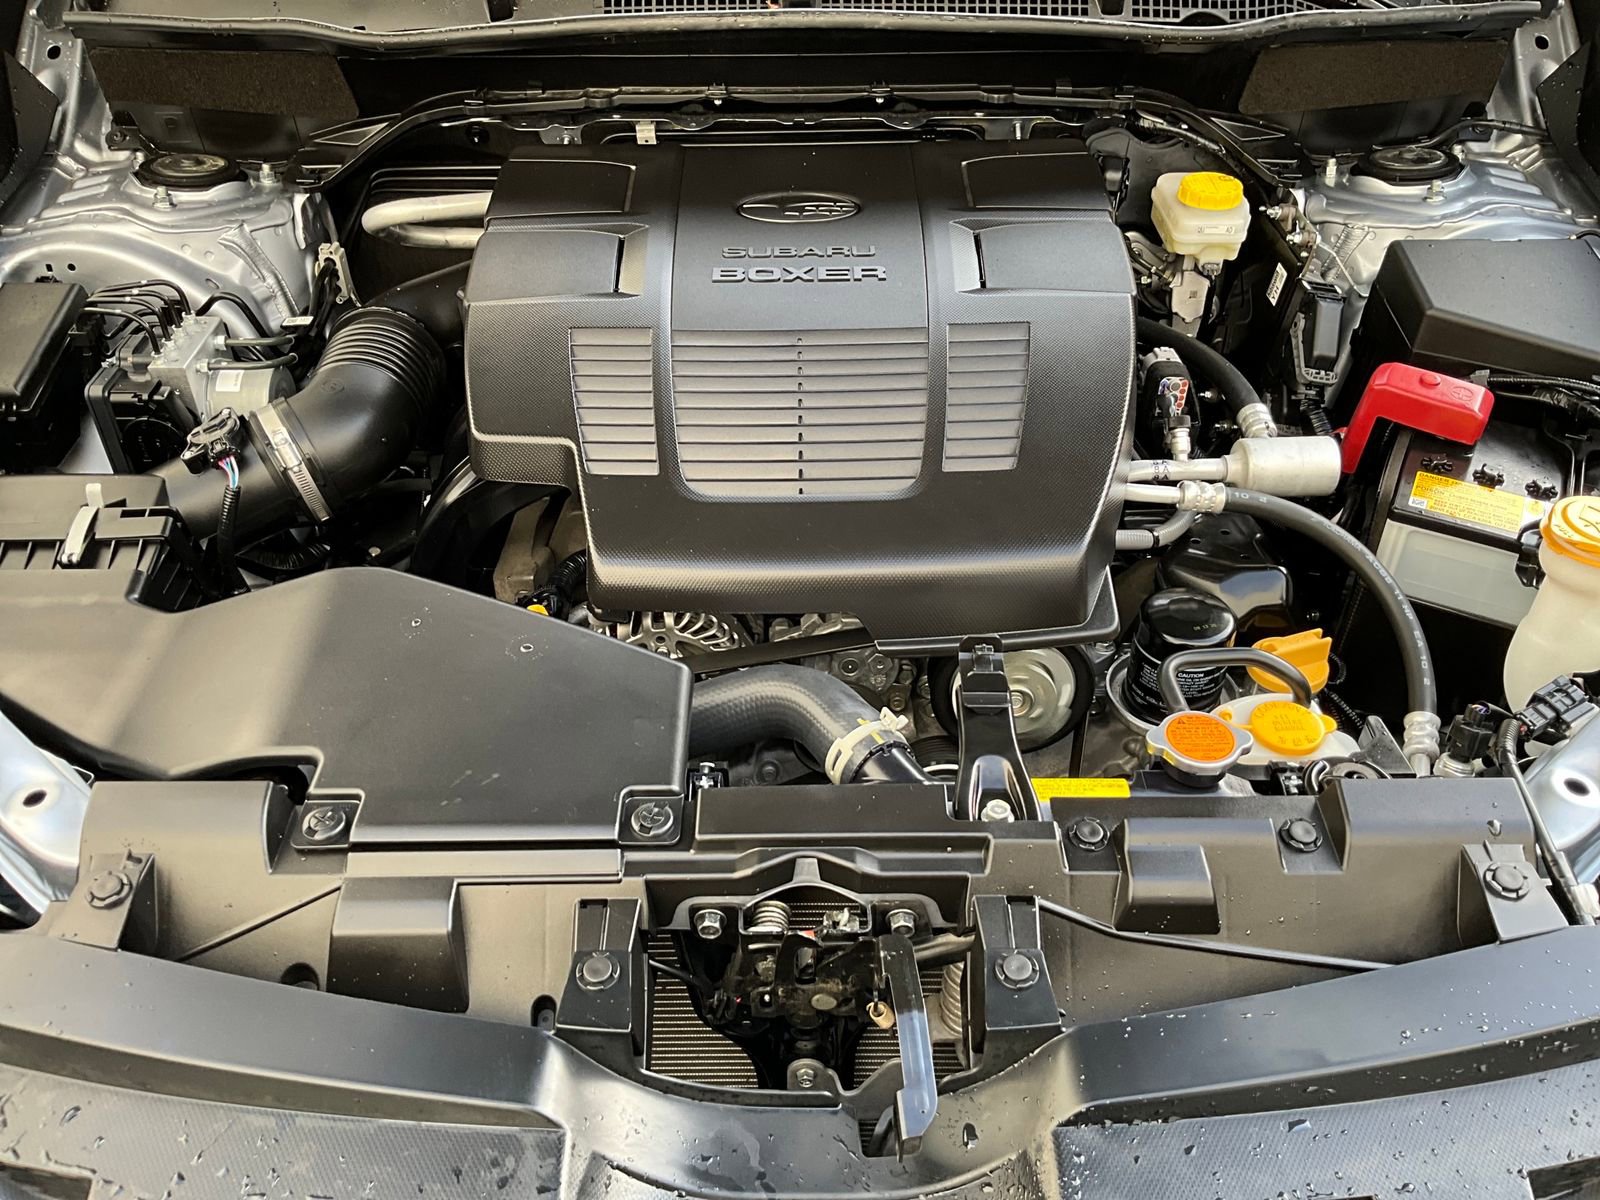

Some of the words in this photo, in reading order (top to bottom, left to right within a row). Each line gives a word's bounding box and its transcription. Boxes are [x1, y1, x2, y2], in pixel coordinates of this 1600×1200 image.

[722, 245, 876, 259] SUBARU
[711, 265, 887, 283] BOXER
[1420, 655, 1428, 669] 10
